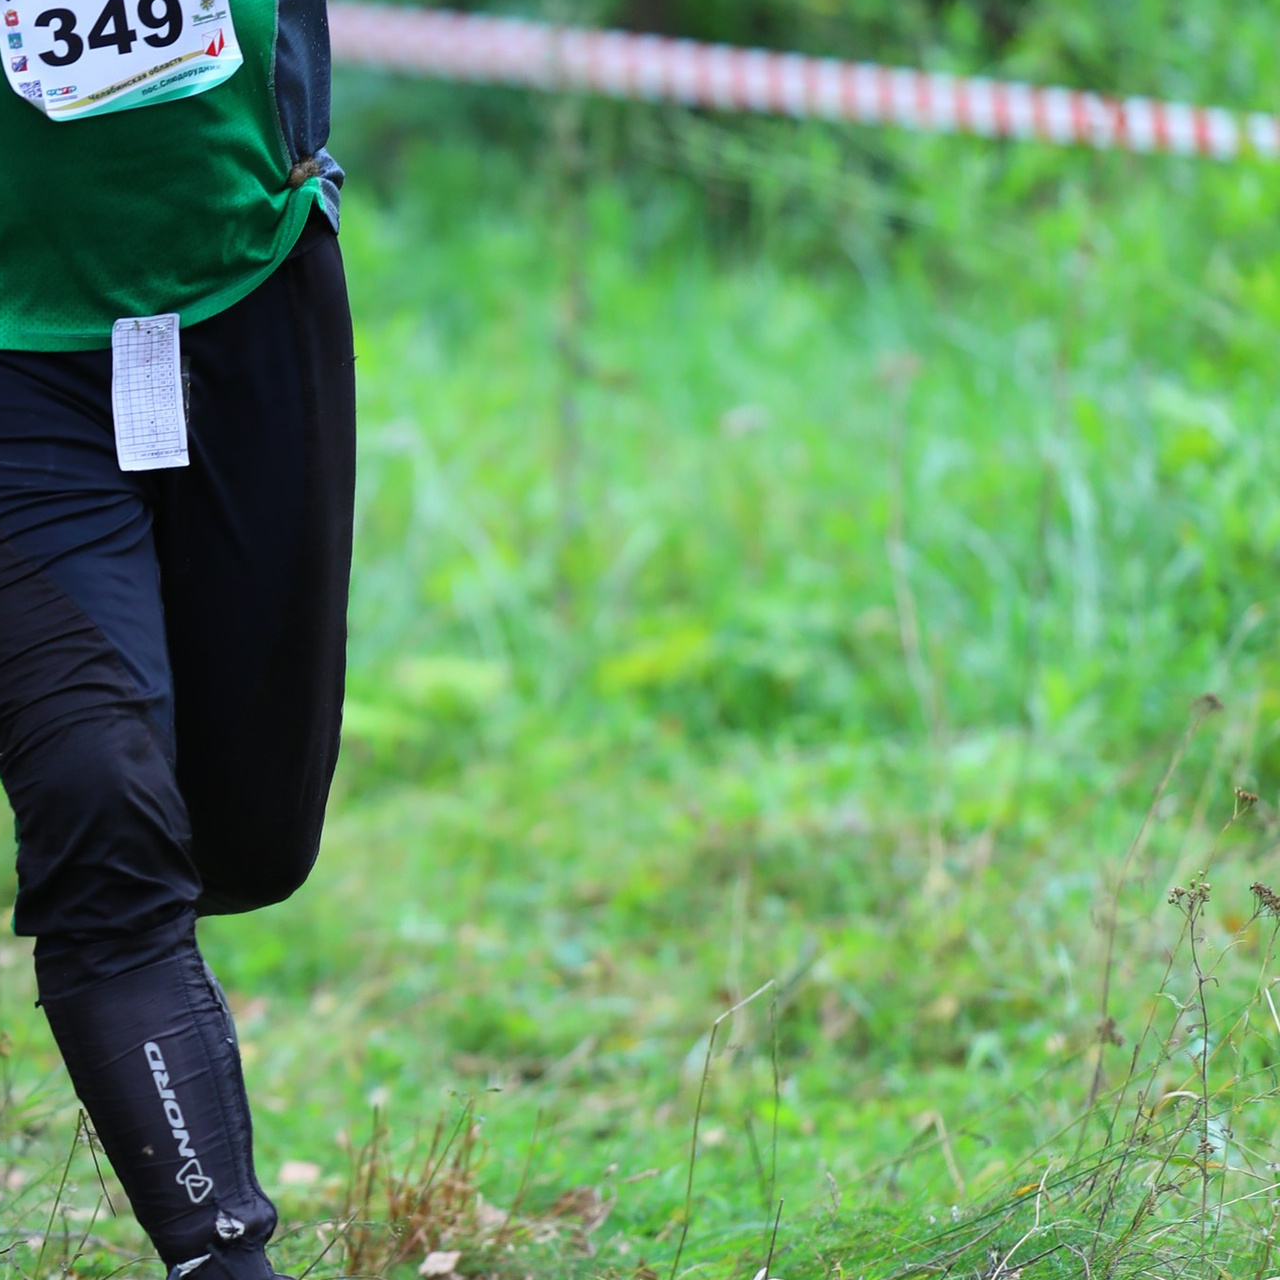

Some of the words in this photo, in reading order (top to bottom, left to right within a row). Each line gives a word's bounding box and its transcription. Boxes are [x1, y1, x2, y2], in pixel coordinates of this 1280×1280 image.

[88, 72, 147, 100] Челябинская
[148, 56, 183, 75] область
[144, 1041, 196, 1158] NORD
